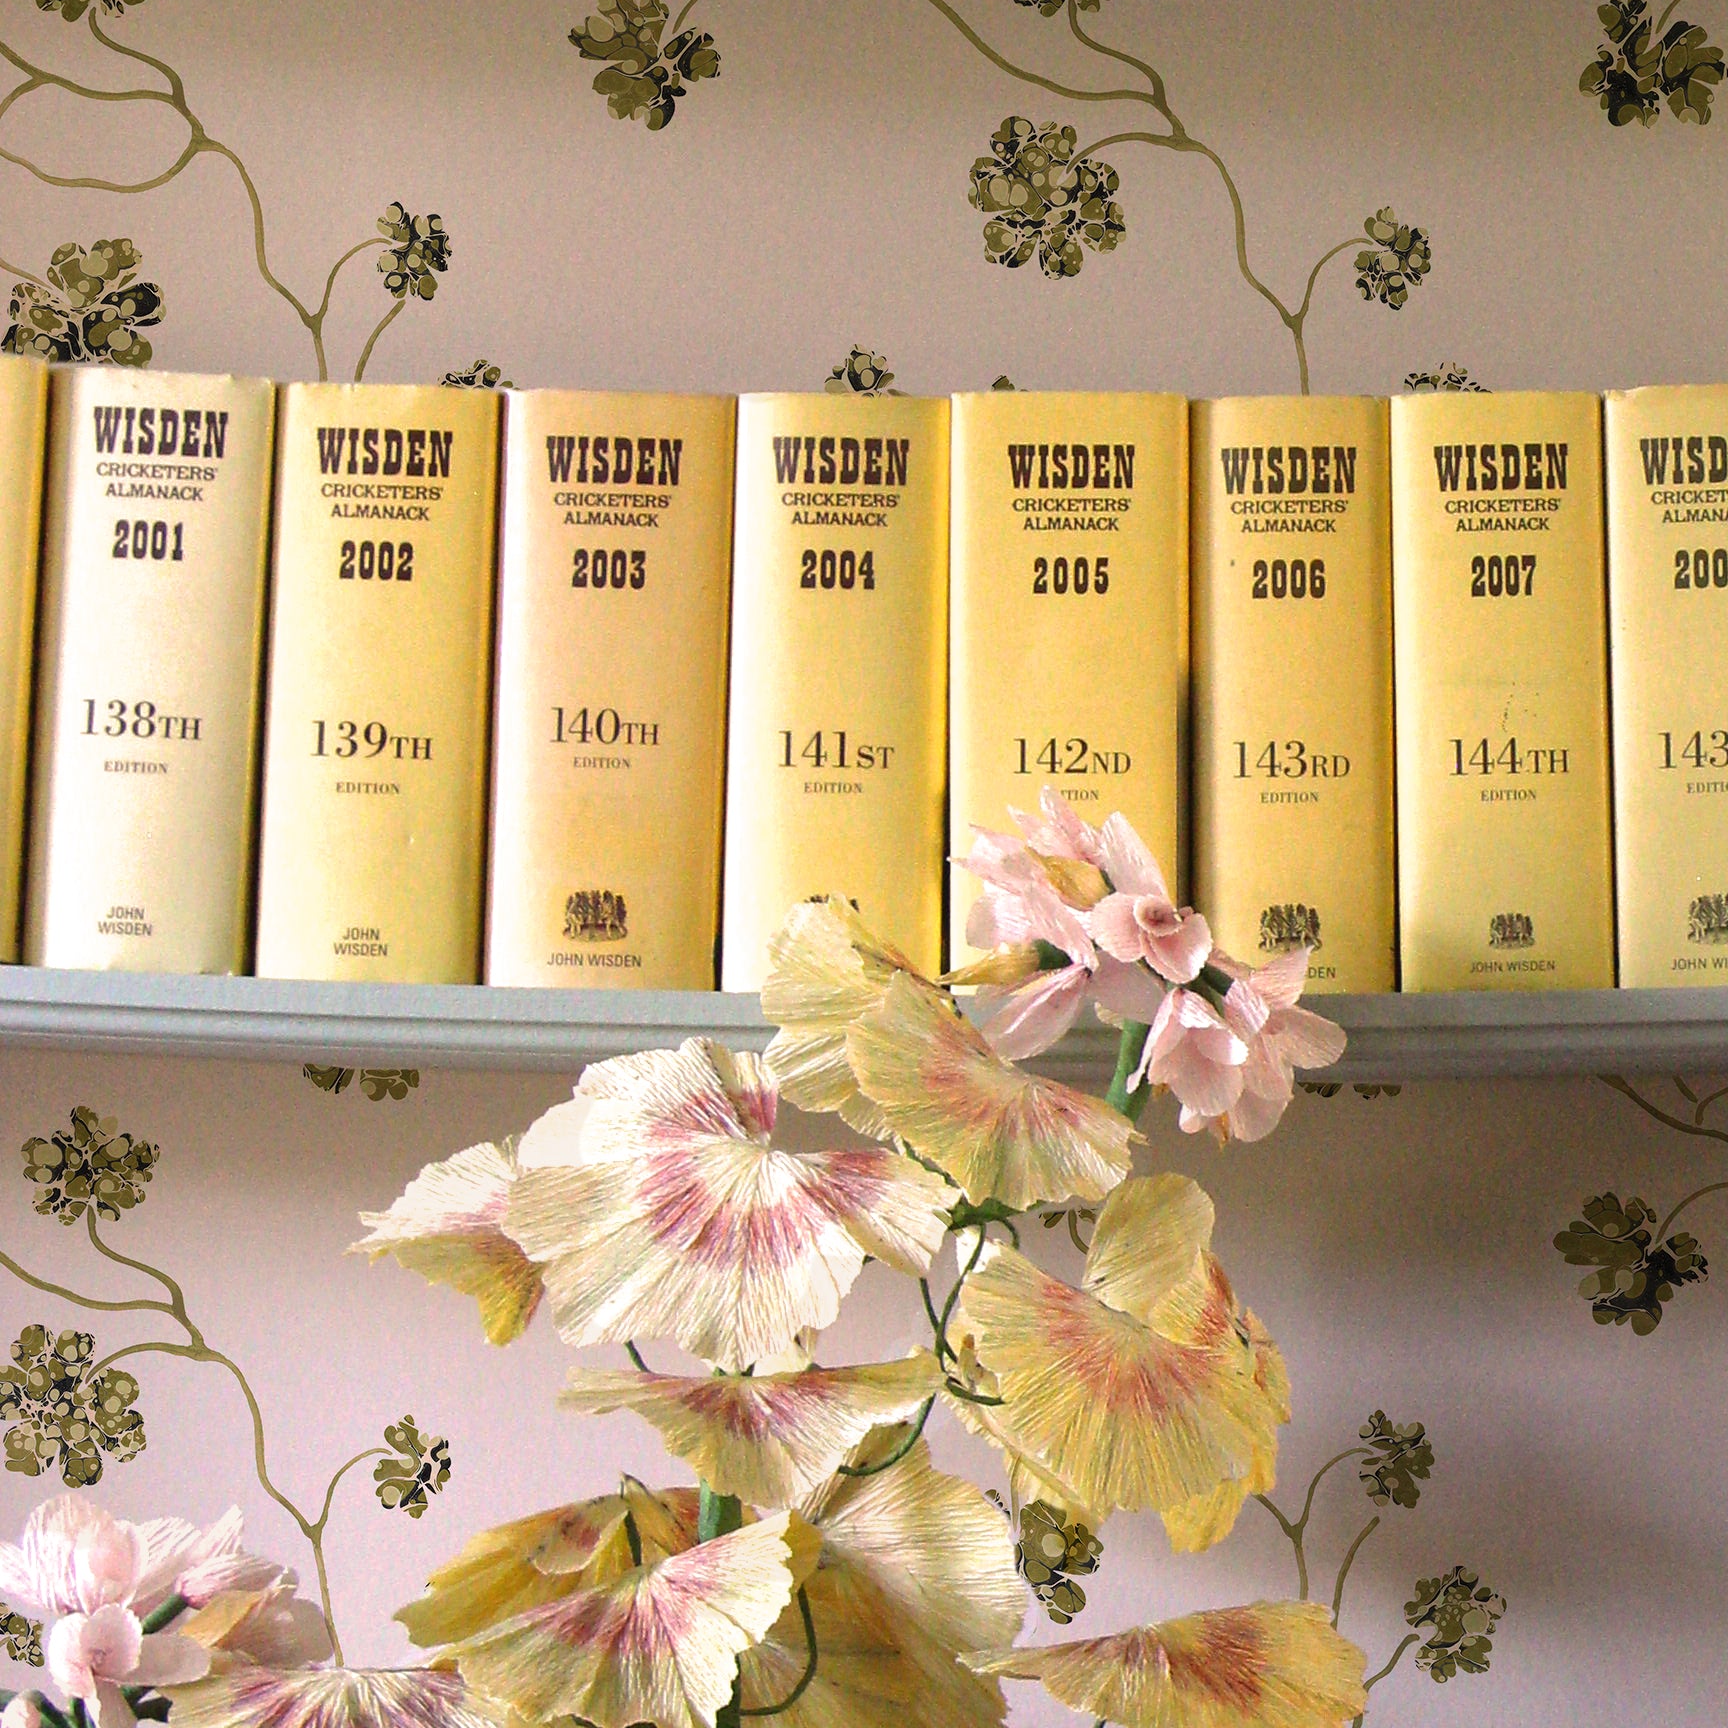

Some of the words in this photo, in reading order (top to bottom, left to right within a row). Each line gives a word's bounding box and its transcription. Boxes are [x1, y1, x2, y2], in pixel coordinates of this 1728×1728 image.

[94, 407, 228, 458] WISDEN
[317, 428, 452, 477] WISDEN
[546, 436, 682, 486] WISDEN
[773, 437, 909, 486] WISDEN
[1008, 444, 1135, 489] WISDEN
[1221, 447, 1356, 494] WISDEN
[1434, 443, 1568, 492] WISDEN
[106, 483, 203, 501] ALMANACK
[331, 504, 429, 521] ALMANACK
[564, 511, 658, 527] ALMANACK
[792, 511, 887, 526] ALMANACK
[1024, 517, 1118, 531] ALMANACK
[1242, 519, 1336, 533] ALMANACK
[1456, 517, 1549, 532] ALMANACK
[113, 520, 183, 561] 2001
[340, 541, 413, 581] 2002
[572, 549, 645, 589] 2003
[800, 550, 874, 590] 2004
[1033, 557, 1108, 594] 2005
[1252, 559, 1325, 599] 2006
[1471, 555, 1536, 597] 2007
[85, 700, 201, 740] 138TH
[552, 708, 658, 745] 140TH
[310, 721, 434, 760] 139TH
[780, 731, 894, 769] 141ST
[1014, 738, 1130, 773] 142ND
[1450, 738, 1568, 775] 144TH
[104, 761, 167, 773] EDITION
[574, 757, 630, 769] EDITION
[1234, 741, 1350, 778] 143RD
[336, 782, 399, 794] EDITION
[805, 782, 862, 793] EDITION
[1061, 790, 1098, 801] TION
[1481, 789, 1536, 801] EDITION
[1261, 792, 1318, 803] EDITION
[107, 906, 144, 920] JOHN
[98, 922, 152, 936] WISDEN
[343, 928, 379, 941] JOHN
[334, 943, 387, 956] WISDEN
[547, 953, 583, 966] JOHN
[588, 954, 641, 967] WISDEN
[1470, 961, 1503, 973] JOHN
[1507, 960, 1555, 972] WISDEN
[1671, 958, 1707, 970] JOHN
[1308, 966, 1336, 979] DEN
